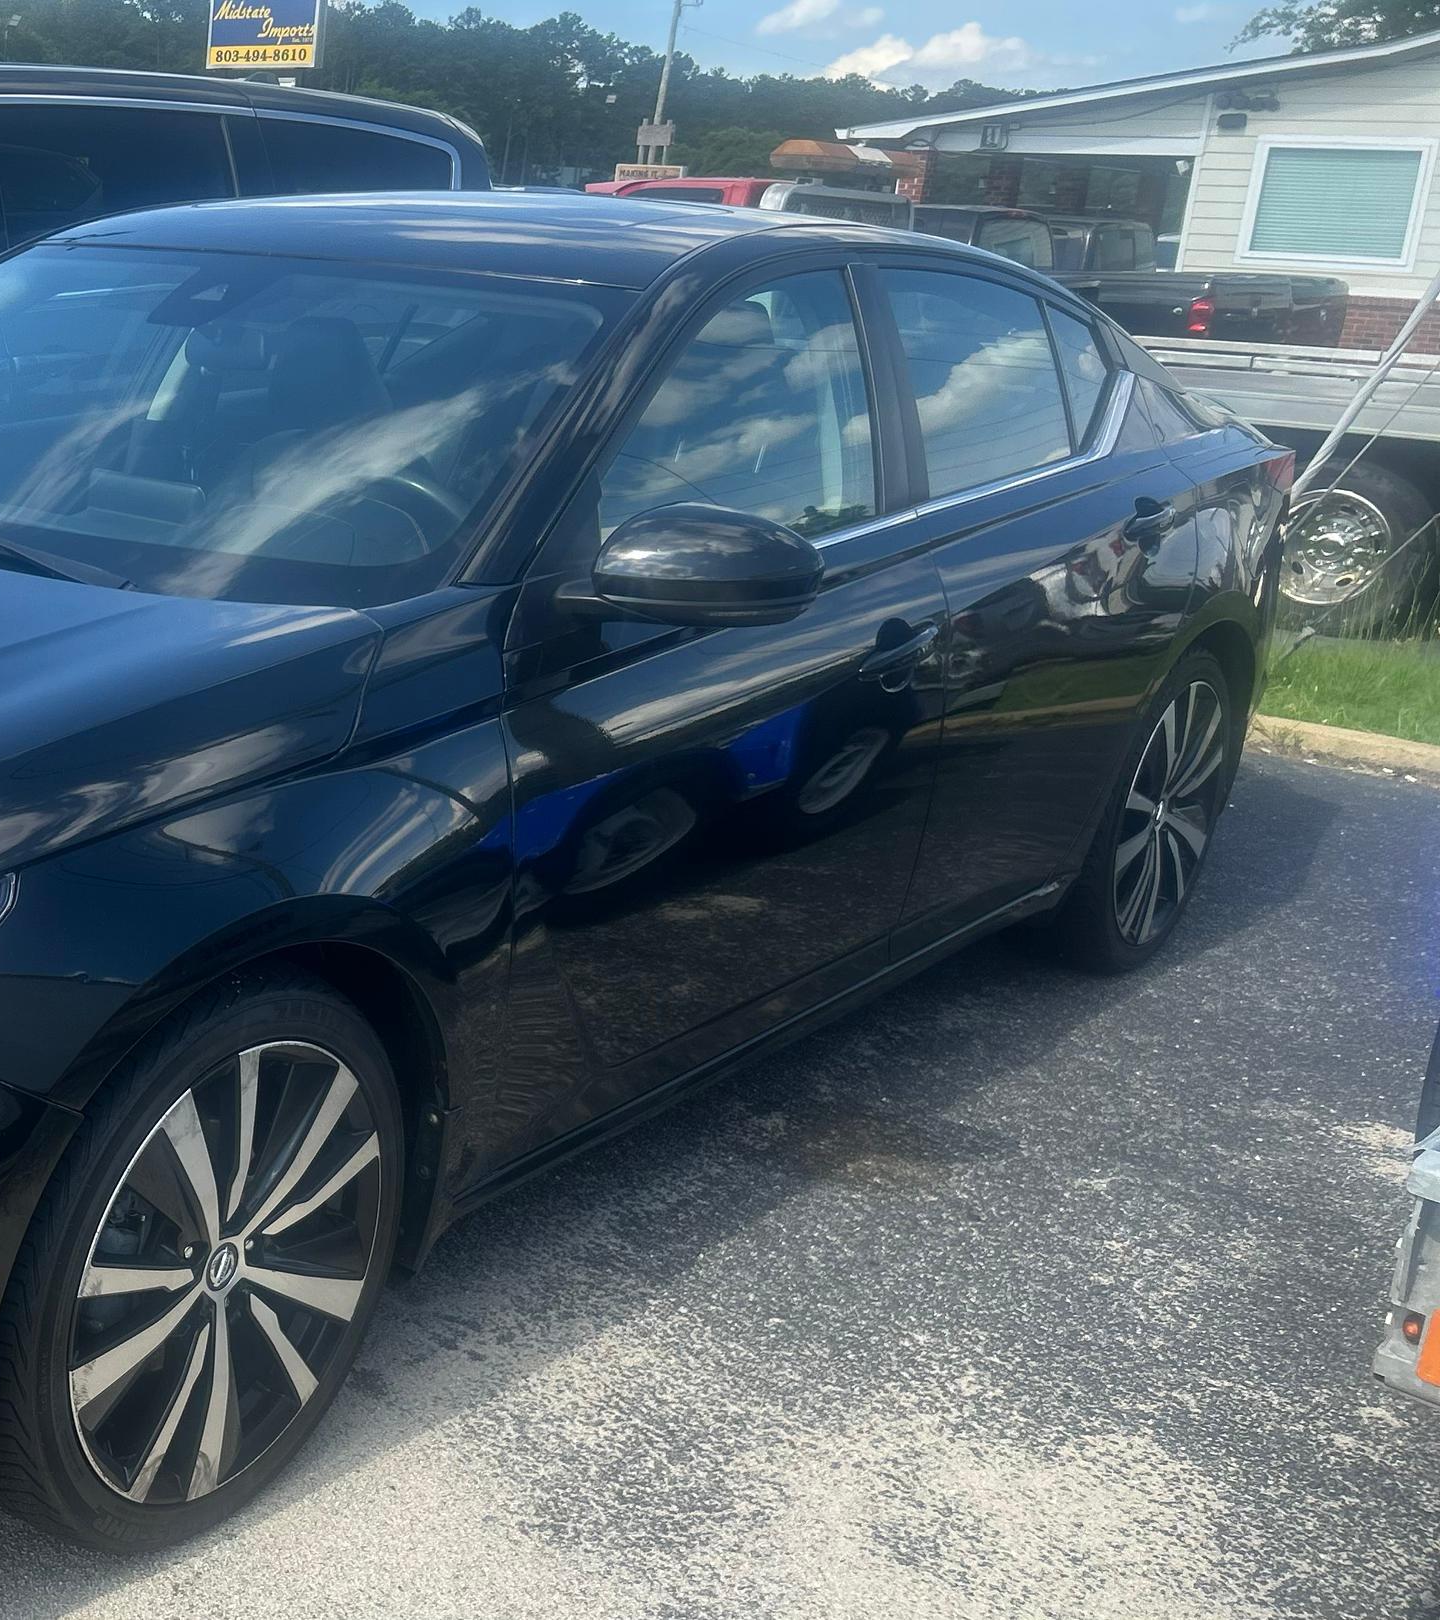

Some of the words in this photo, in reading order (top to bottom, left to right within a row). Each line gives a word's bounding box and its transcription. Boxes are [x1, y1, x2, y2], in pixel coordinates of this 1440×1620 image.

[213, 0, 272, 20] Midstate
[257, 17, 315, 45] Imports
[215, 48, 307, 62] 803-494-8610
